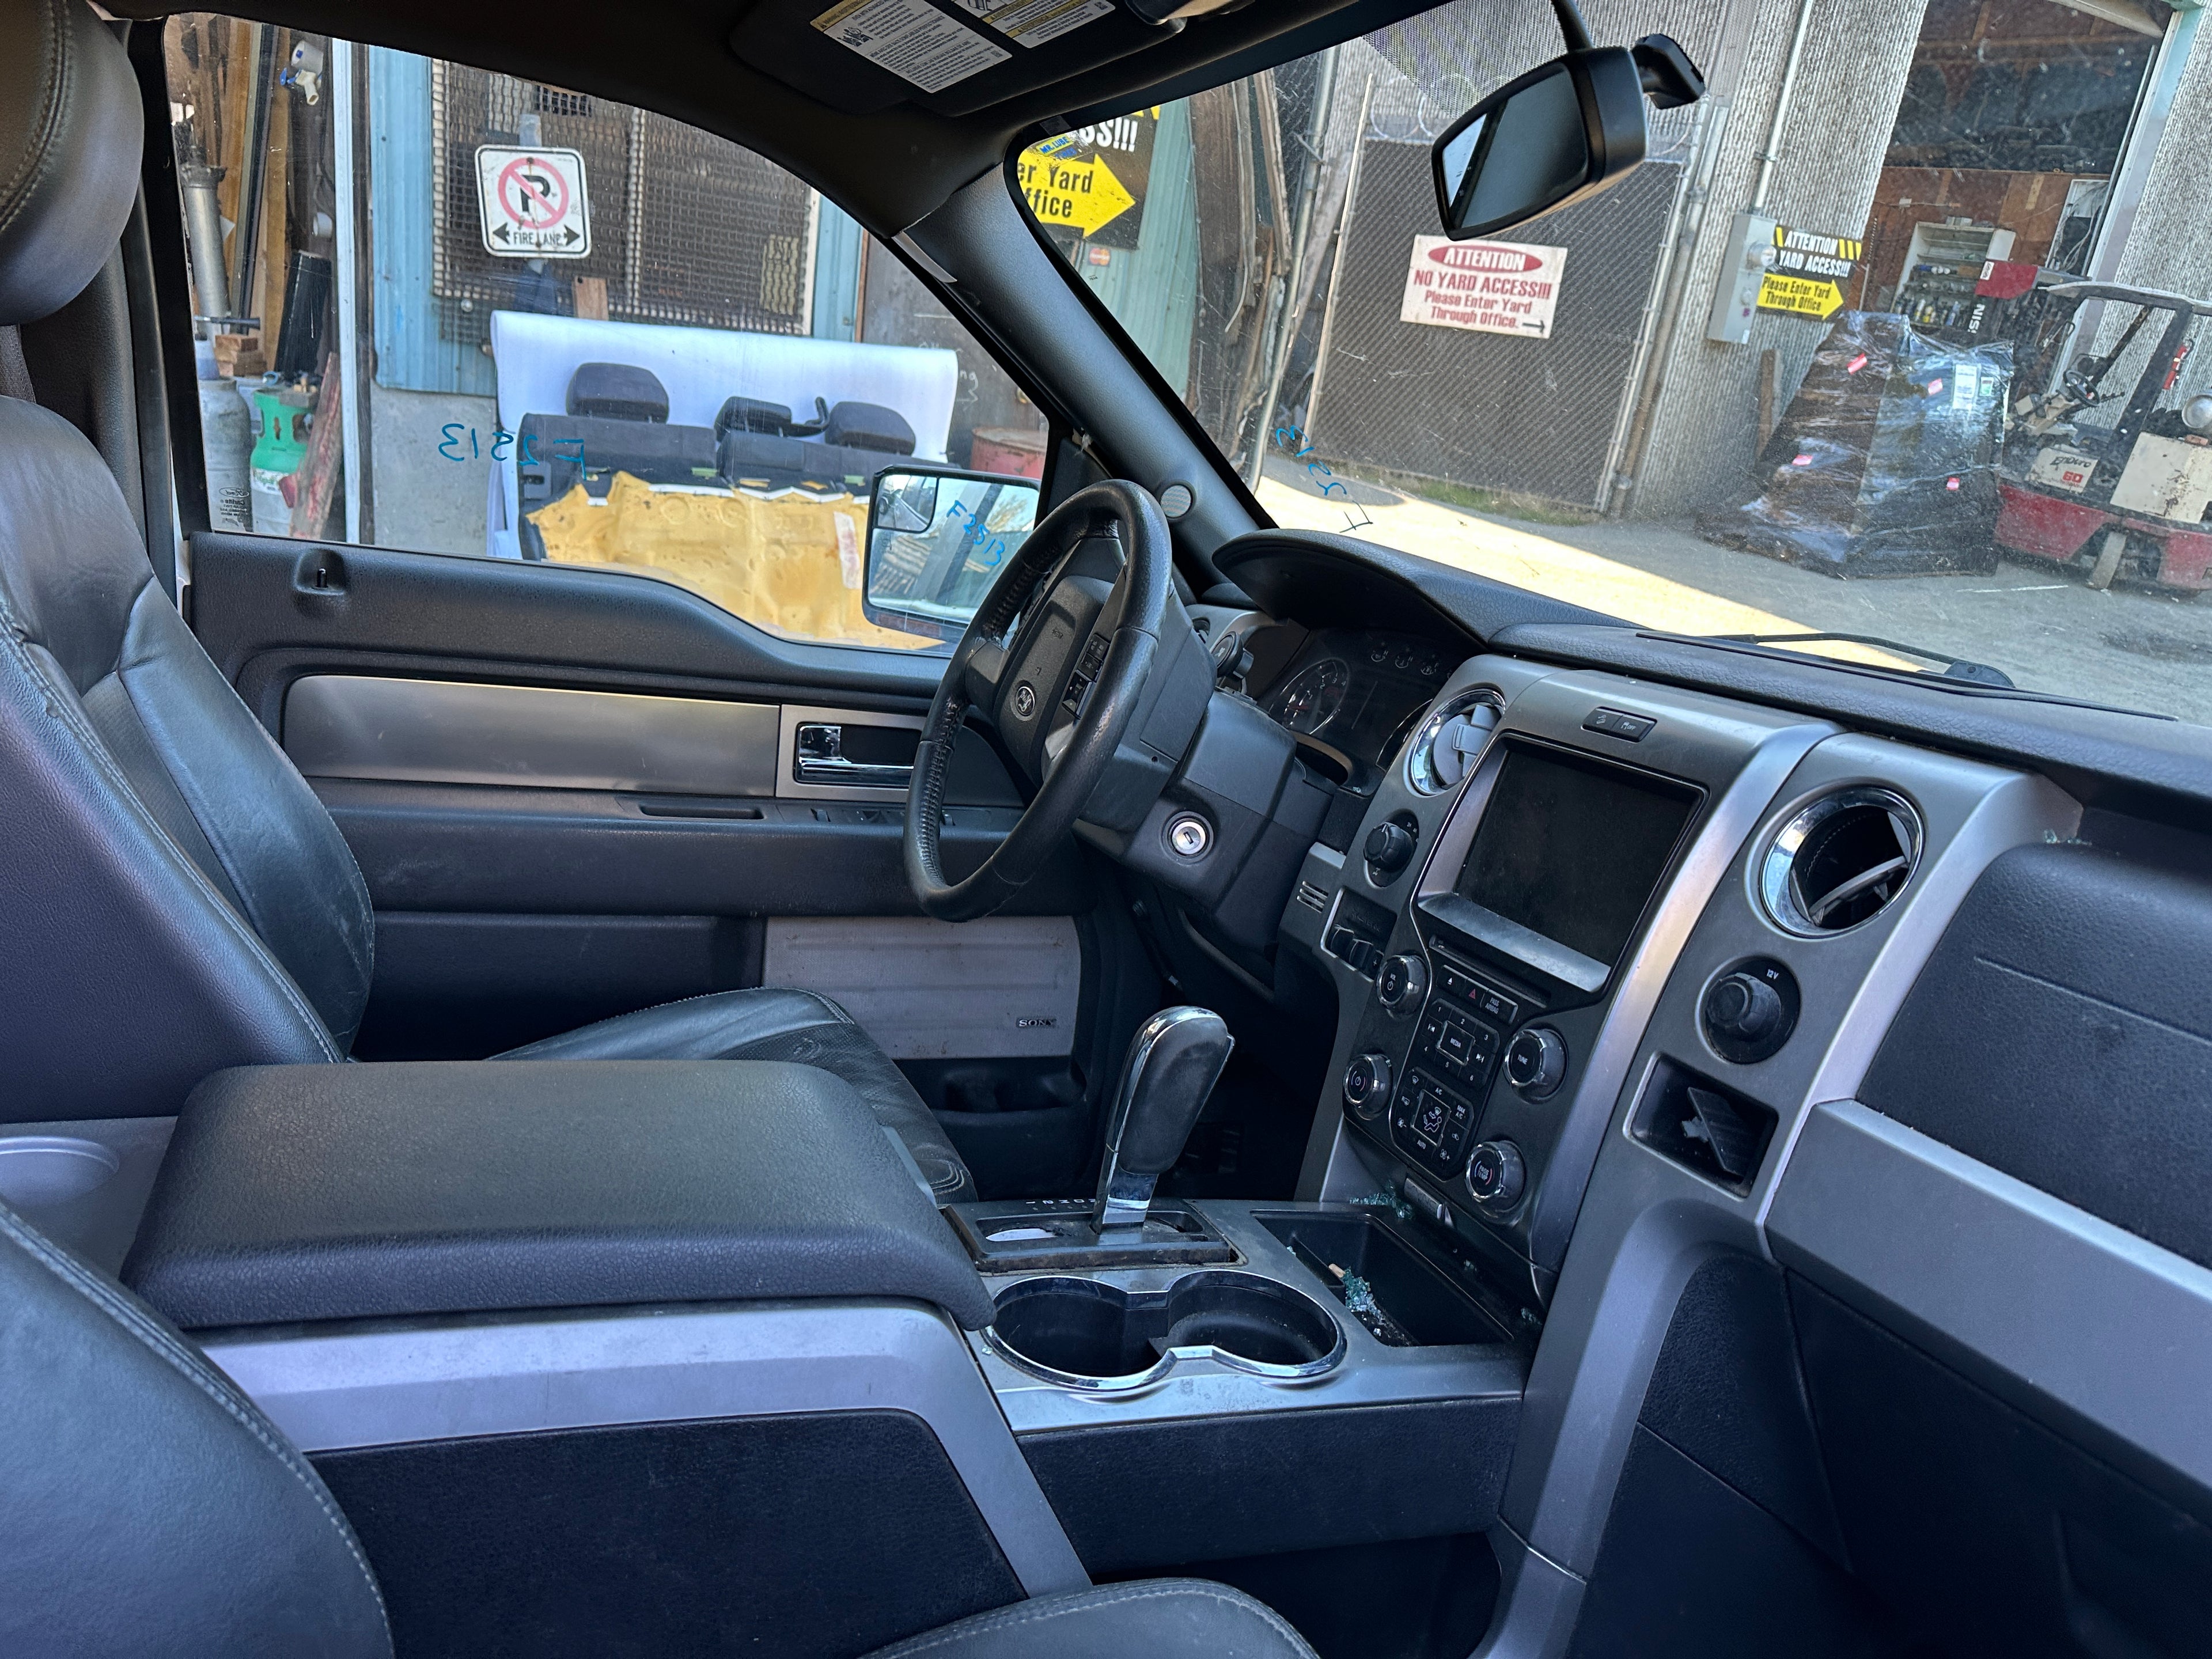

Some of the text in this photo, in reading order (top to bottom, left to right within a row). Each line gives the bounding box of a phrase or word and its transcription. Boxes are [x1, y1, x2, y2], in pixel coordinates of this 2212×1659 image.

[1052, 136, 1070, 148] LUBE
[1048, 164, 1093, 194] Yard
[513, 231, 534, 245] FIRE
[1784, 229, 1838, 255] ATTENTION
[1442, 247, 1527, 271] ATTENTION
[1778, 250, 1851, 278] YARD ACCESS!!!
[1414, 270, 1552, 300] NO YARD ACCESS!!!
[1762, 275, 1832, 300] Please Enter Yard
[1425, 290, 1532, 314] Please Enter Yard
[1765, 290, 1821, 312] Through Office
[1431, 306, 1477, 325] Through
[946, 499, 1005, 566] F2513
[1766, 968, 1779, 980] 12V
[1490, 997, 1499, 1006] PASS
[1018, 1018, 1056, 1027] SONY
[1517, 1054, 1528, 1065] TUNE
[1434, 1087, 1442, 1096] A/C
[1457, 1104, 1466, 1113] MAX
[1455, 1111, 1464, 1120] A/C
[1416, 1139, 1426, 1150] AUTO
[1477, 1170, 1488, 1181] TEMP
[1478, 1165, 1490, 1176] PASS
